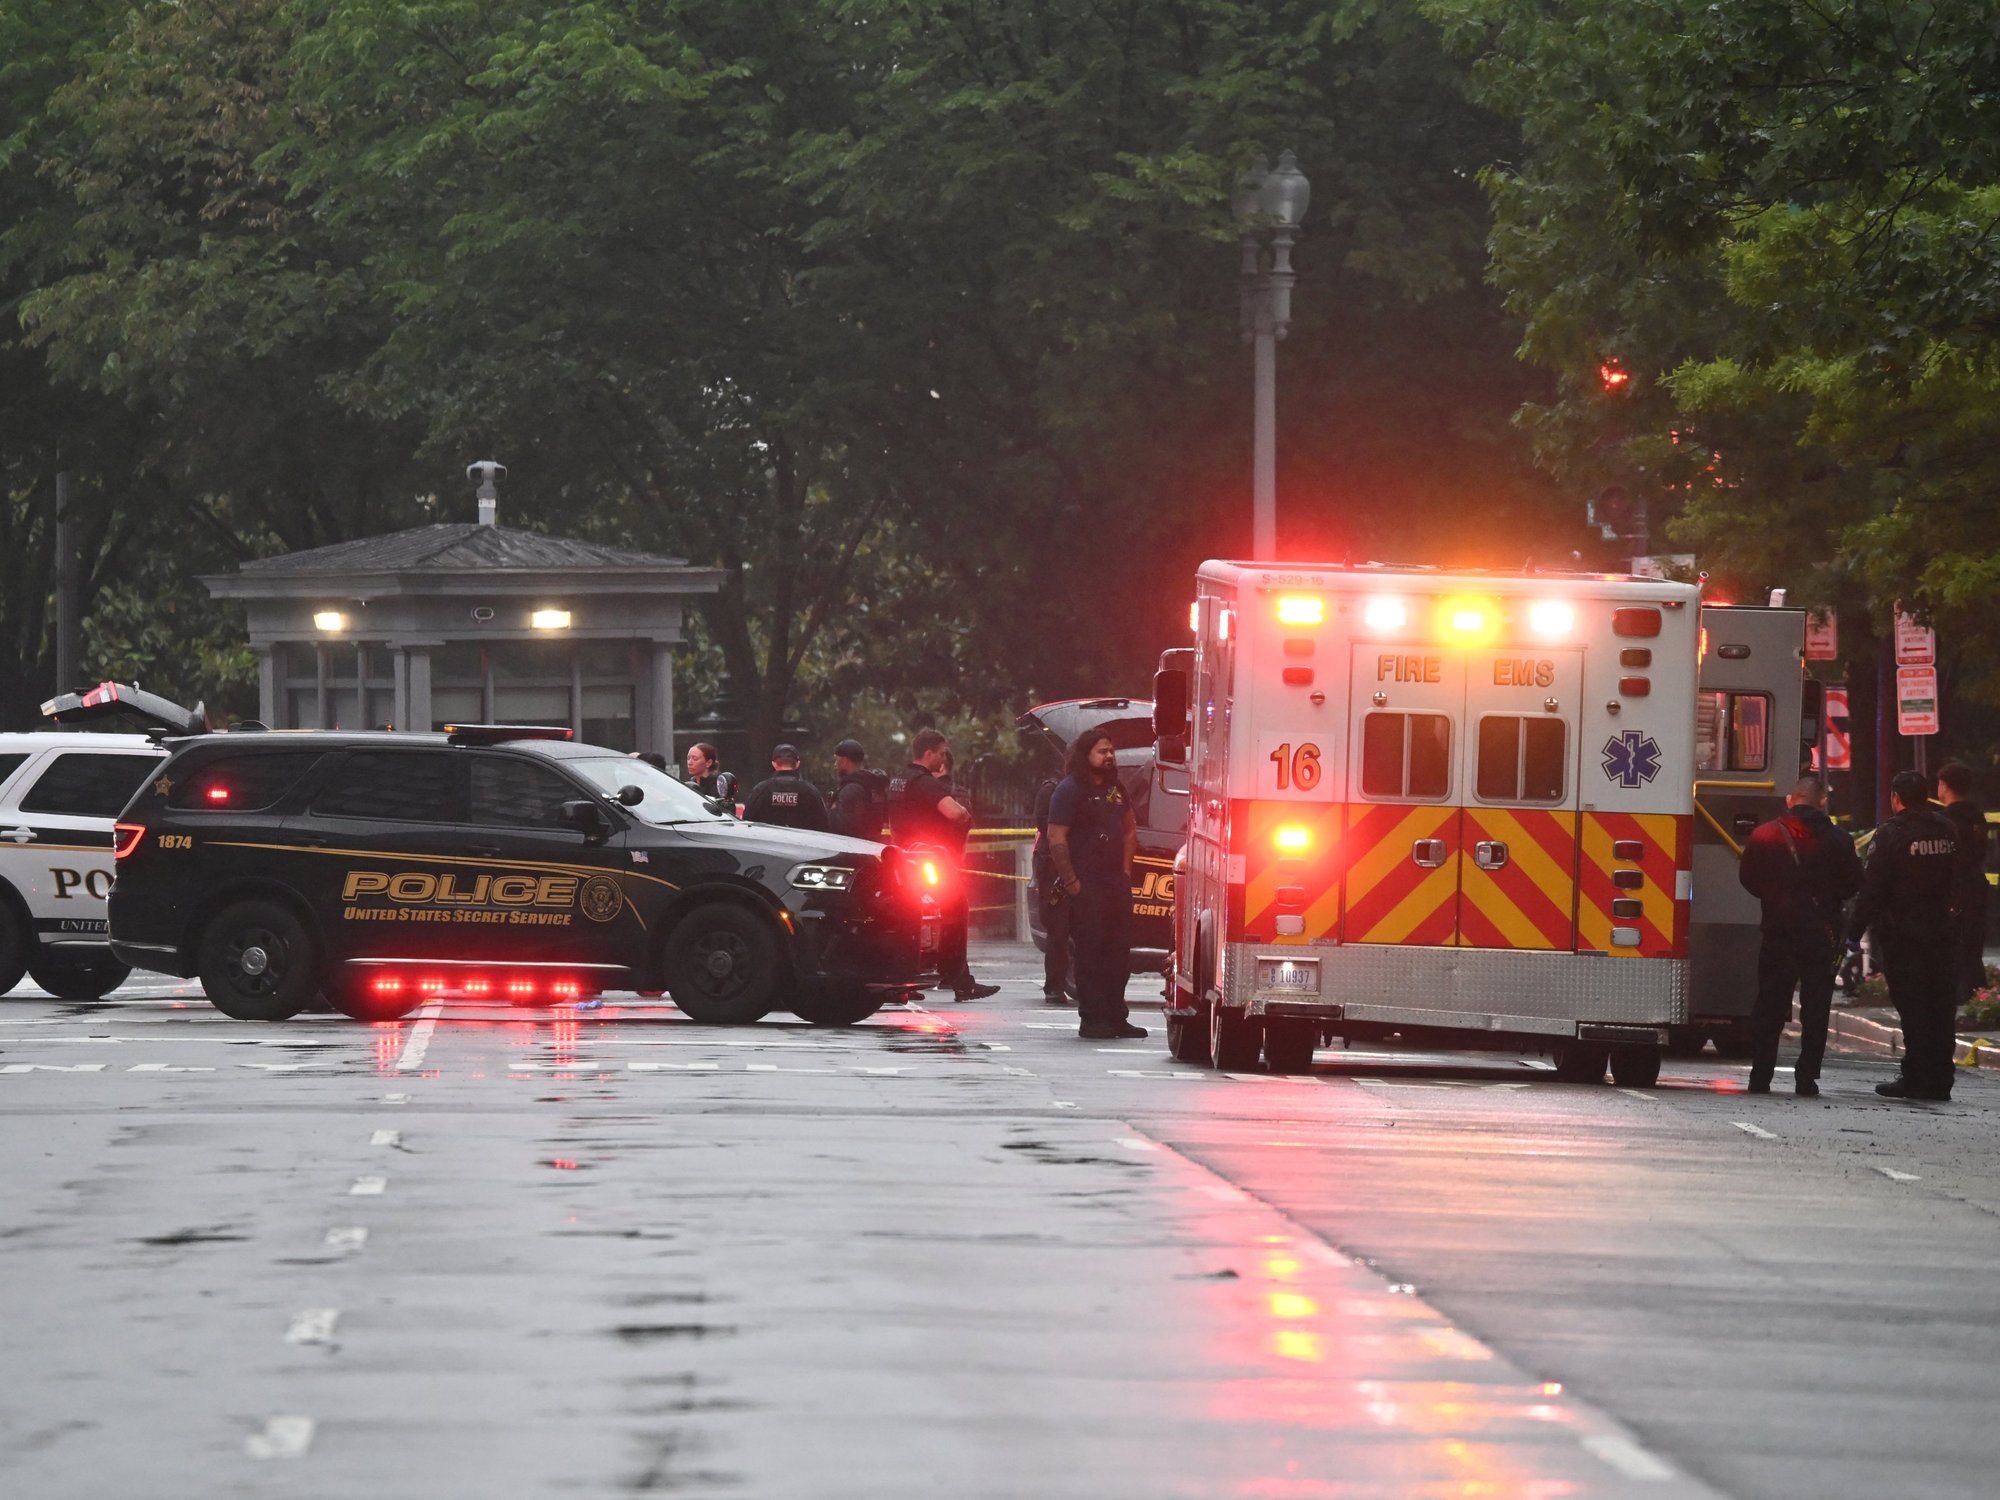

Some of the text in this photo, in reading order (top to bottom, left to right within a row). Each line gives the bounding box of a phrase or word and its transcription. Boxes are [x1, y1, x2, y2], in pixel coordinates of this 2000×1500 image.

[1378, 655, 1555, 688] FIRE EMS
[1270, 742, 1321, 791] 16
[772, 794, 798, 804] POLICE
[158, 835, 193, 849] 1874
[342, 871, 579, 907] POLICE
[344, 907, 572, 925] UNITED STATES SECRET SERVICE
[1279, 970, 1310, 984] 10937
